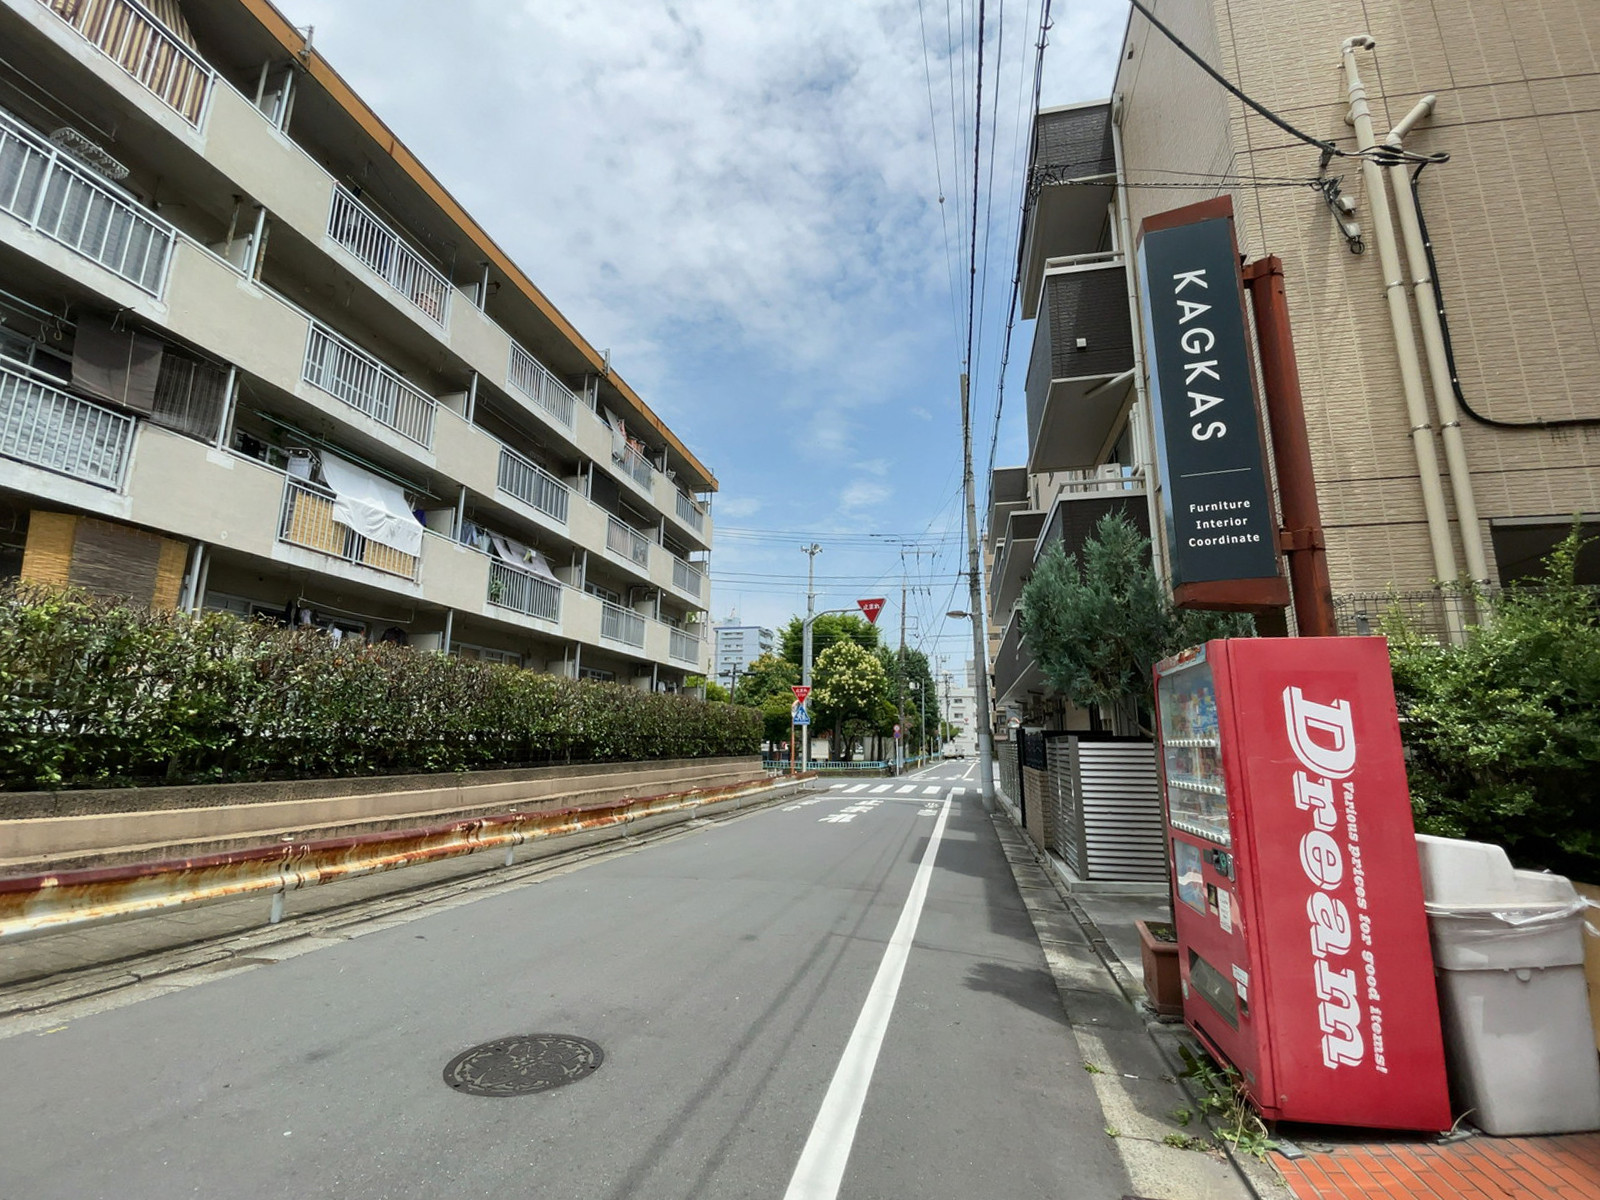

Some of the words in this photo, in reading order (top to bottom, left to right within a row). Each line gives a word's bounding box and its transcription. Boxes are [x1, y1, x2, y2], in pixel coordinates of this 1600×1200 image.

[1173, 269, 1226, 441] KAGKAS
[1189, 500, 1251, 513] Furniture
[1196, 517, 1248, 529] Interior
[1188, 533, 1260, 547] Coordinate
[1342, 782, 1359, 842] Various
[1282, 685, 1365, 1070] Dream
[1348, 843, 1368, 910] prices
[1359, 913, 1372, 946] for
[1361, 950, 1381, 1001] good
[1369, 1005, 1388, 1074] items!
